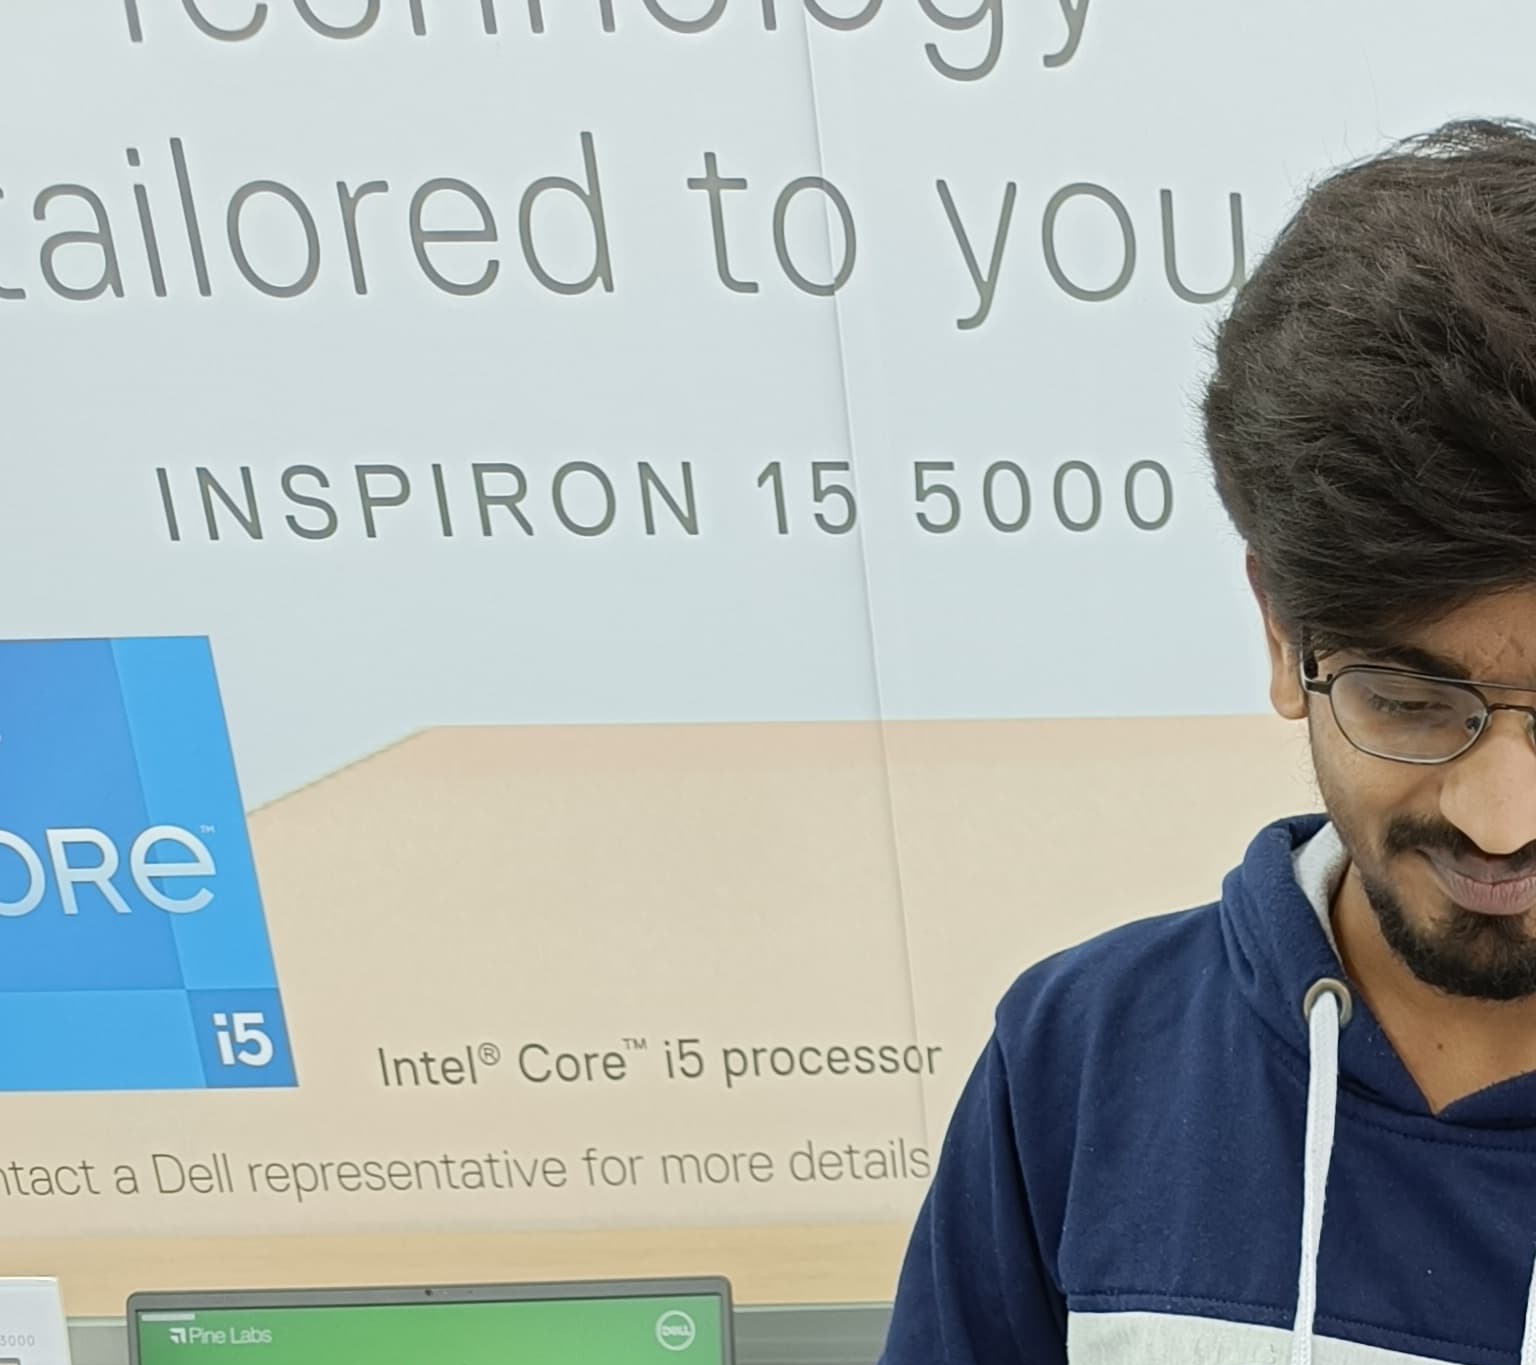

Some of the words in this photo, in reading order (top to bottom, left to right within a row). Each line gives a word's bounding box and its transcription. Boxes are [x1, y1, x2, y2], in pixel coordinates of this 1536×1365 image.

[688, 152, 857, 298] to
[934, 178, 1248, 330] you
[154, 460, 701, 542] INSPIRON
[757, 461, 859, 536] 15
[914, 459, 1176, 534] 5000
[212, 1012, 274, 1066] i5
[663, 1038, 704, 1079] i5
[722, 1045, 943, 1089] processor
[114, 1165, 139, 1194] a
[152, 1152, 234, 1194] Dell
[248, 1150, 567, 1203] representative
[582, 1147, 645, 1187] for
[661, 1150, 775, 1184] more
[789, 1137, 931, 1182] details
[189, 1327, 226, 1345] Pine
[230, 1327, 272, 1344] Labs
